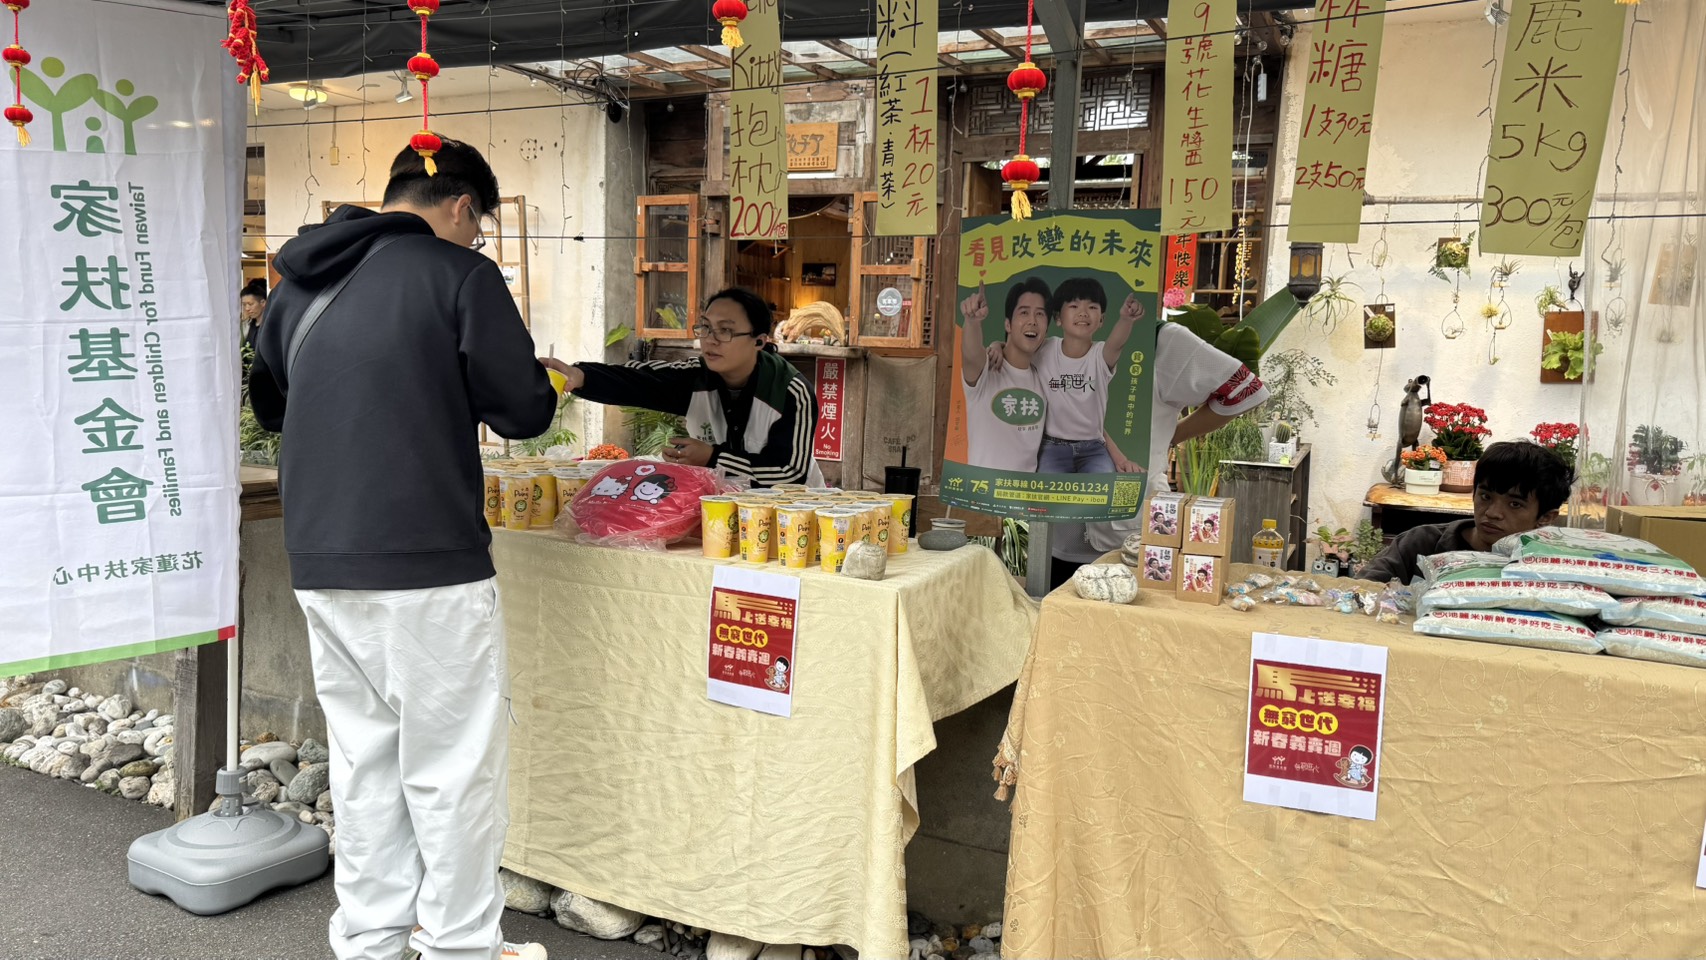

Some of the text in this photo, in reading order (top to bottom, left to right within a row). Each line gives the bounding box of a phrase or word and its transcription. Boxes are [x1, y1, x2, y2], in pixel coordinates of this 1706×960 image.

[731, 44, 782, 95] Kitty
[731, 102, 778, 196] 抱枕
[820, 362, 839, 441] 嚴禁煙火
[1001, 393, 1040, 418] 家扶
[815, 449, 840, 458] Smoking
[1030, 479, 1110, 494] 04-22061234
